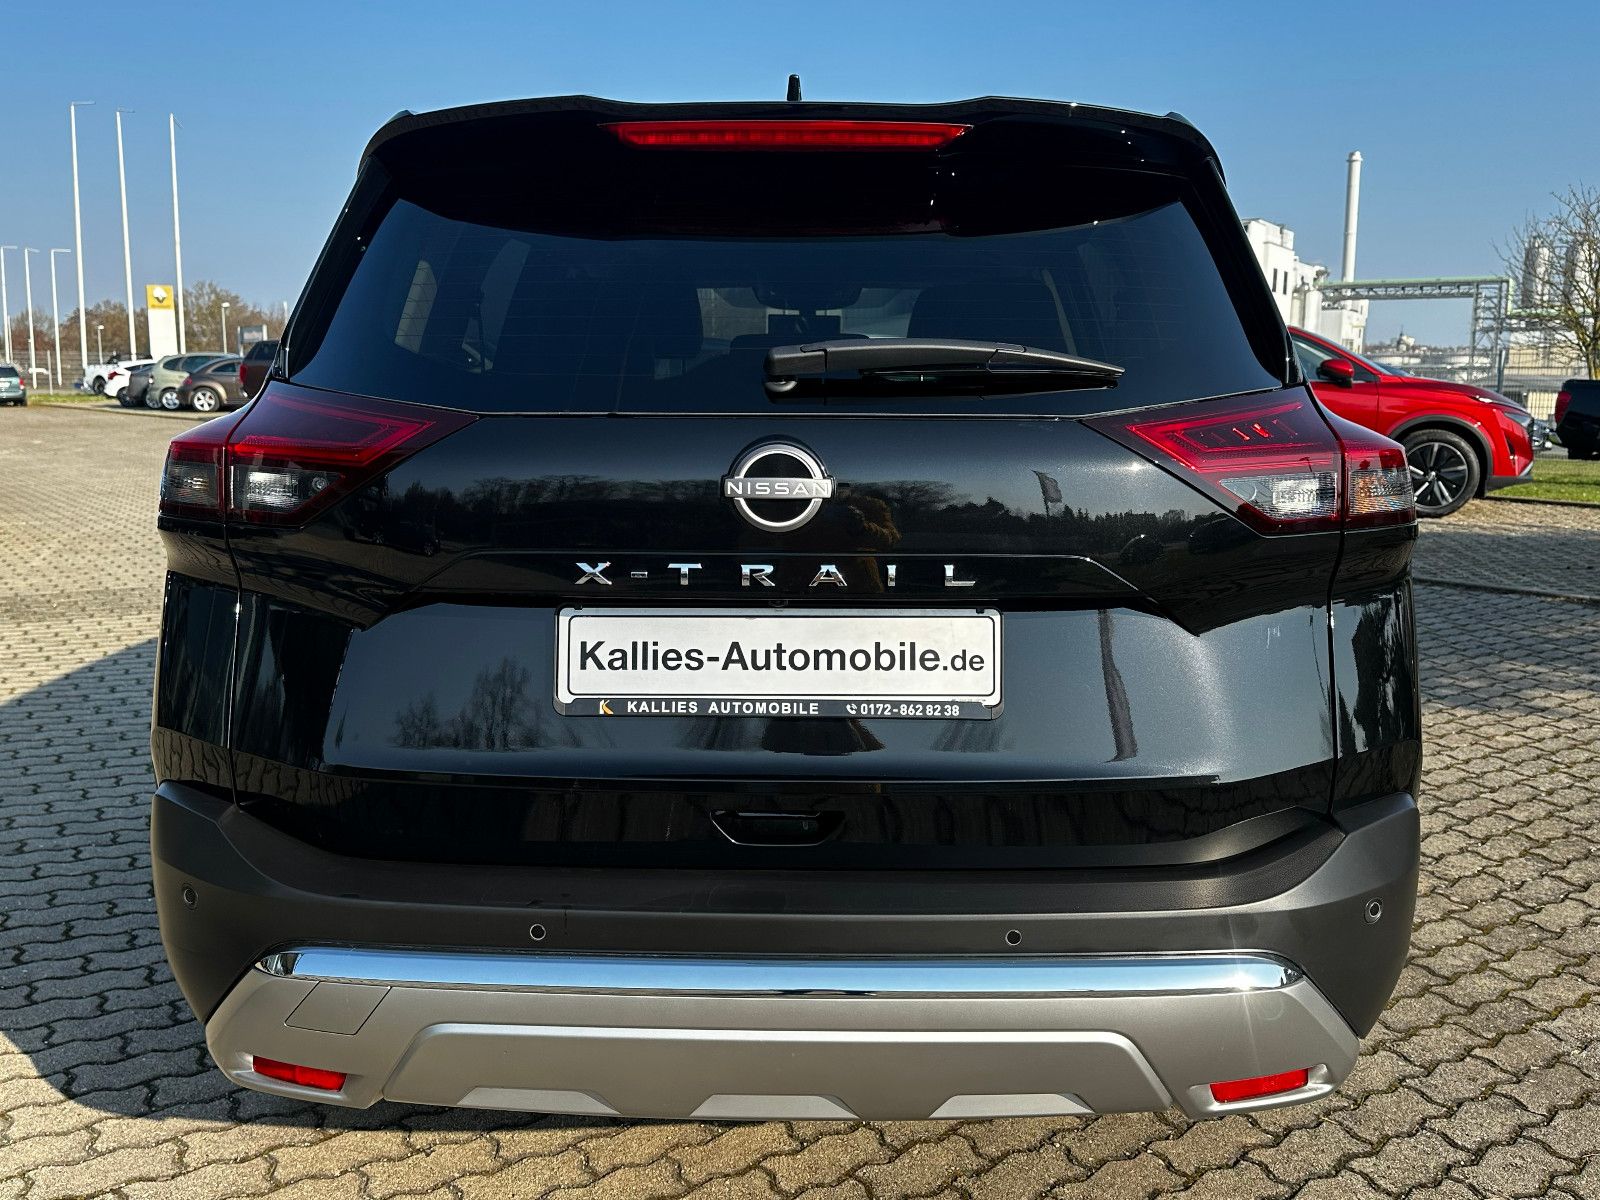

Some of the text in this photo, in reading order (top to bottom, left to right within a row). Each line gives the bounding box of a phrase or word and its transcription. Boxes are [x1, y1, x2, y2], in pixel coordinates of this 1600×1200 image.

[727, 481, 829, 496] NISSAN
[574, 561, 977, 587] X-TRAIL
[579, 639, 986, 672] Kallies-Automobile.de
[627, 701, 819, 715] KALLIES AUTOMOBILE
